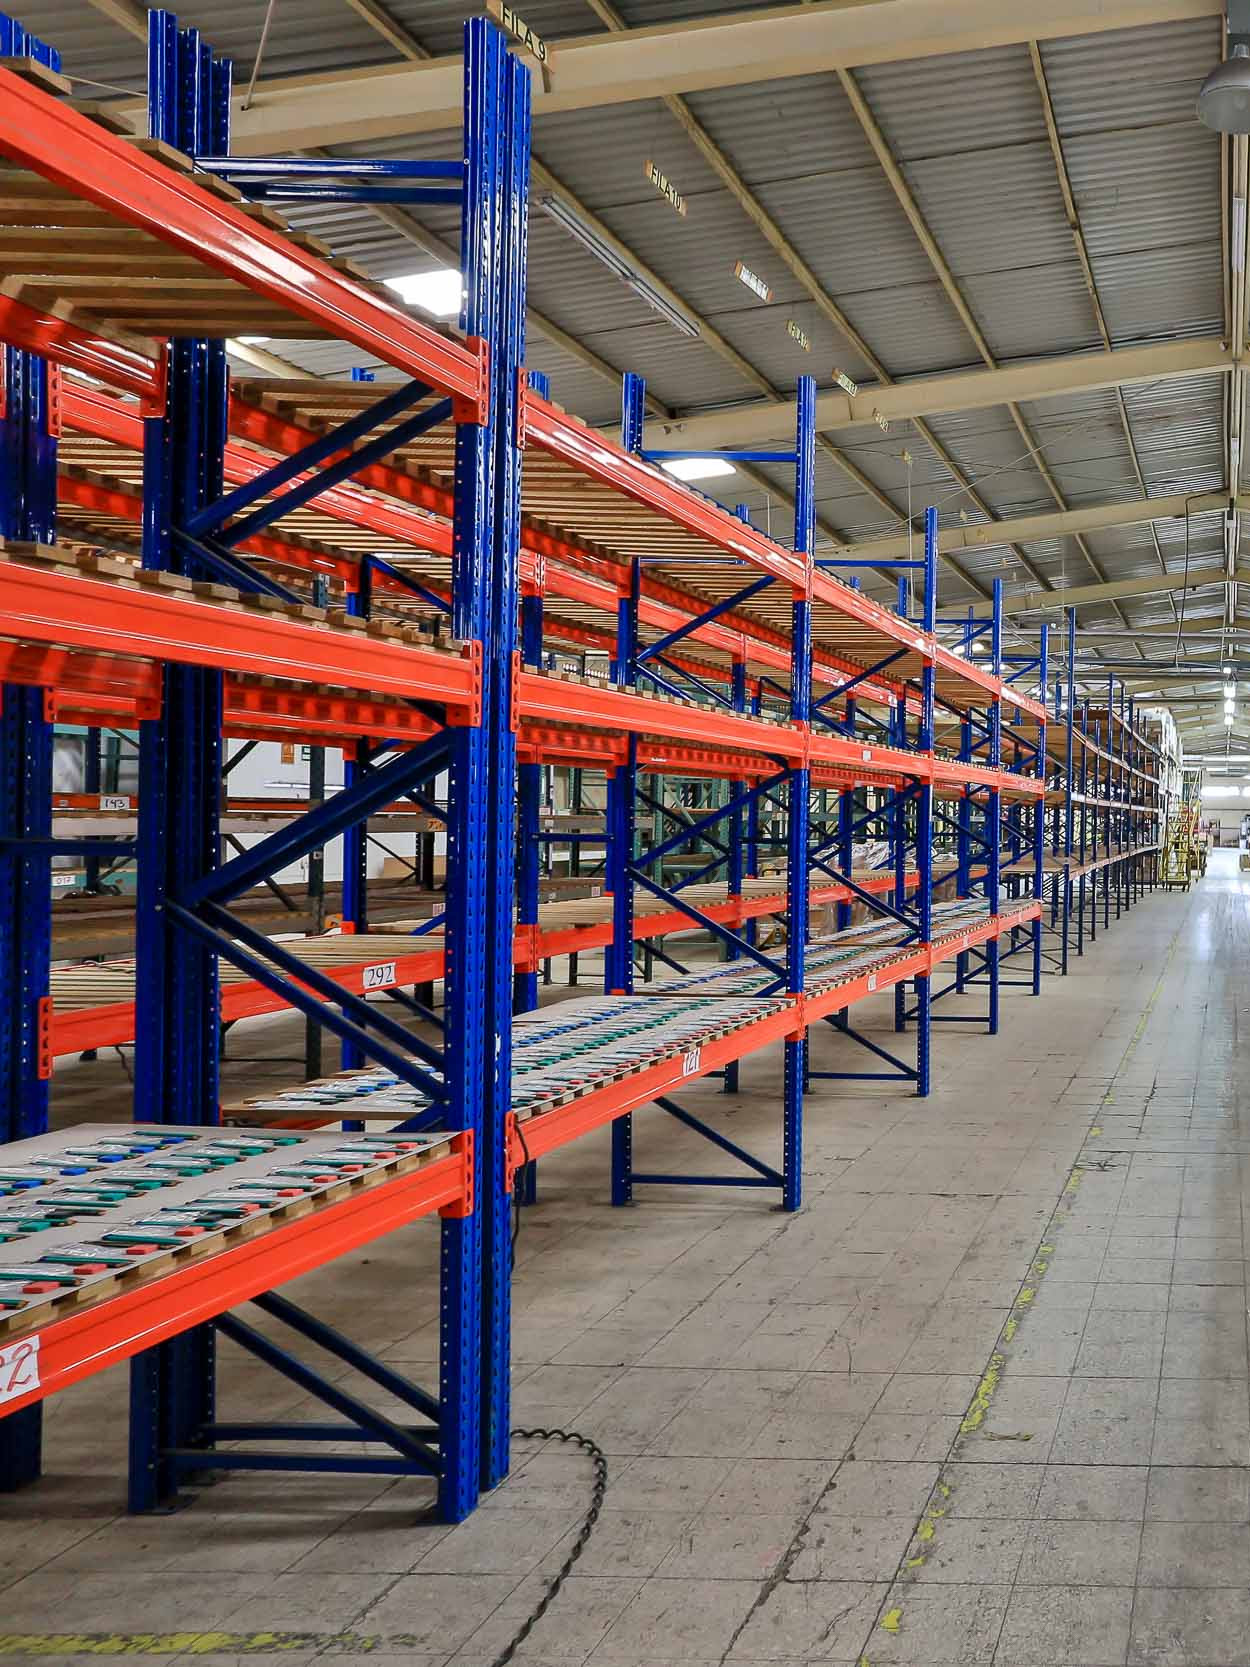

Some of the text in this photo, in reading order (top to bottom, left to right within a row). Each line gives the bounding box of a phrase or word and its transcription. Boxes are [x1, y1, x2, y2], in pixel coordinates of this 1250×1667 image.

[502, 1, 546, 61] FILA 9
[651, 165, 670, 200] FILA
[368, 965, 393, 986] 292
